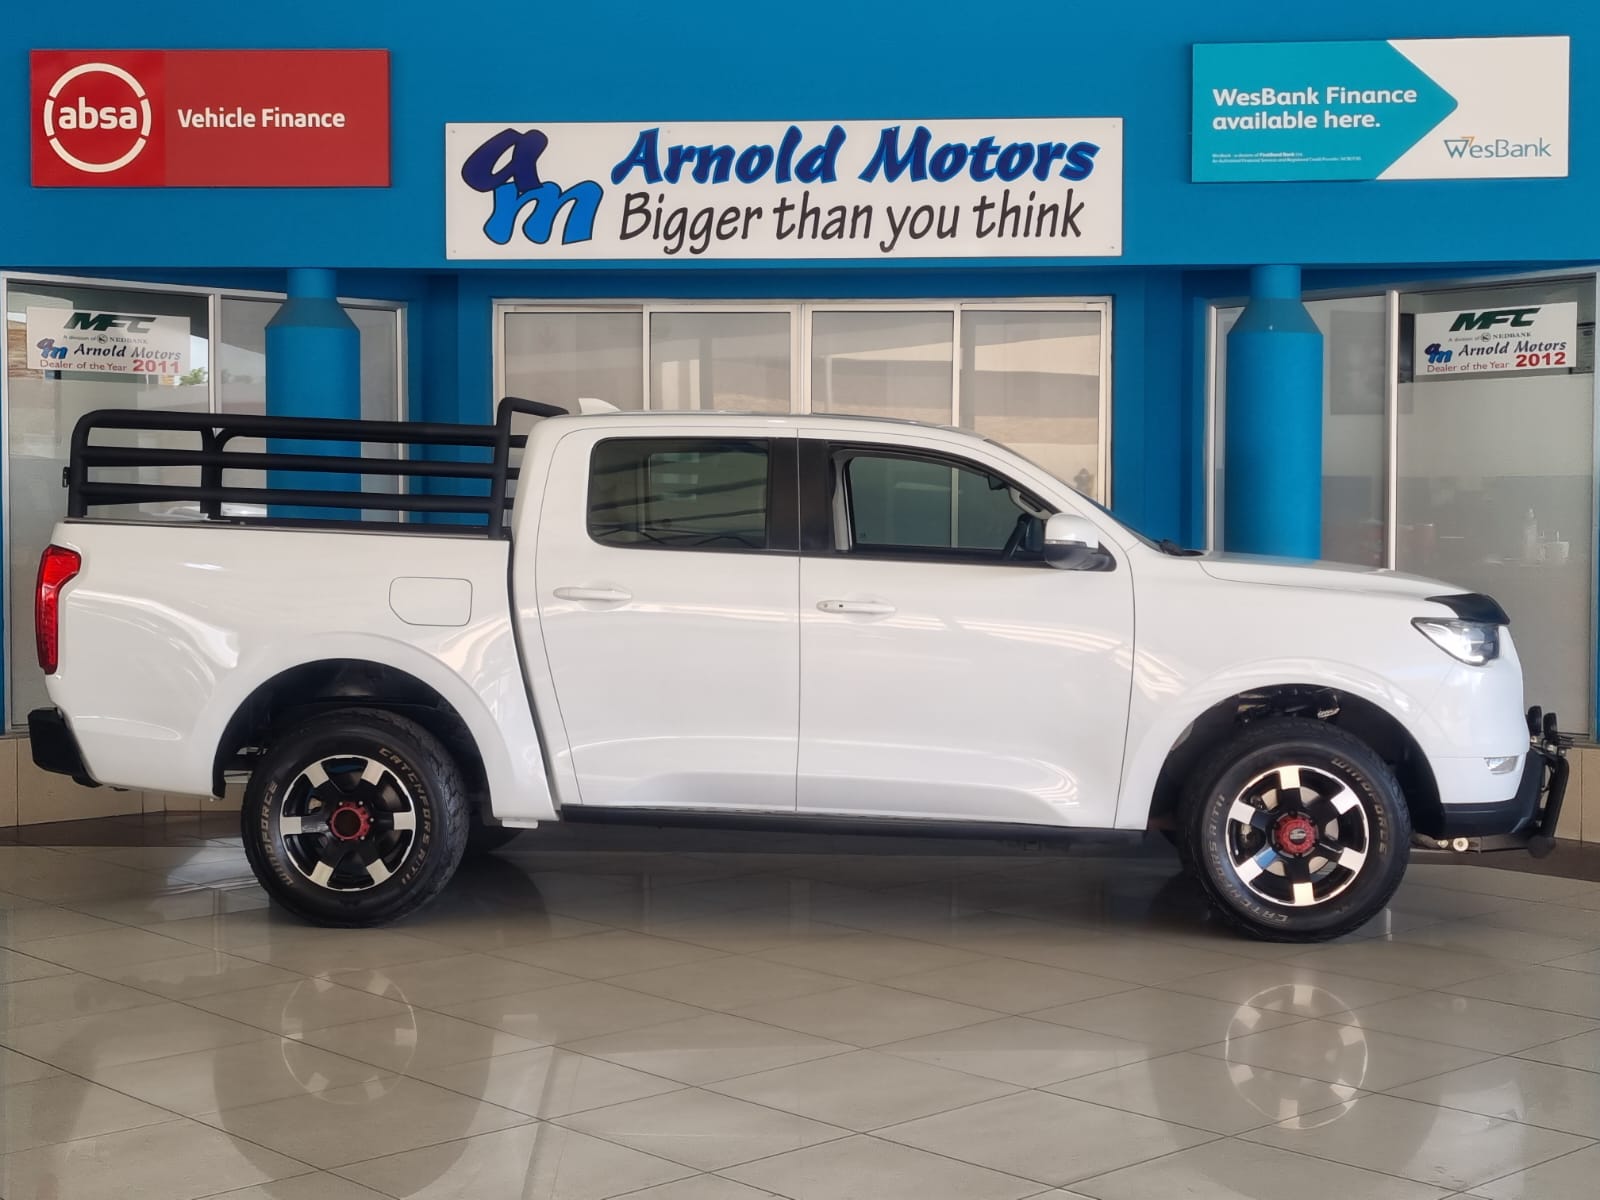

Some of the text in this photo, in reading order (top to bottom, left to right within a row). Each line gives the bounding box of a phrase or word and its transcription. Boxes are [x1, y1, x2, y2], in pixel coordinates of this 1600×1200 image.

[1213, 86, 1417, 106] WesBank Finance
[58, 96, 138, 129] absa
[177, 107, 345, 128] Vehicle Finance
[1212, 110, 1381, 130] available here.
[611, 125, 1101, 184] Arnold Motors
[1443, 136, 1552, 160] WesBank
[619, 188, 1086, 254] Bigger than you think
[64, 312, 156, 334] MFC
[1449, 307, 1541, 332] MFC
[1492, 332, 1532, 340] NEDBANK
[74, 343, 181, 361] Arnold Motors
[1458, 340, 1567, 357] Arnold Motors
[40, 359, 180, 374] Dealer of the Year 2011
[1427, 352, 1567, 374] Dealer of the Year 2012
